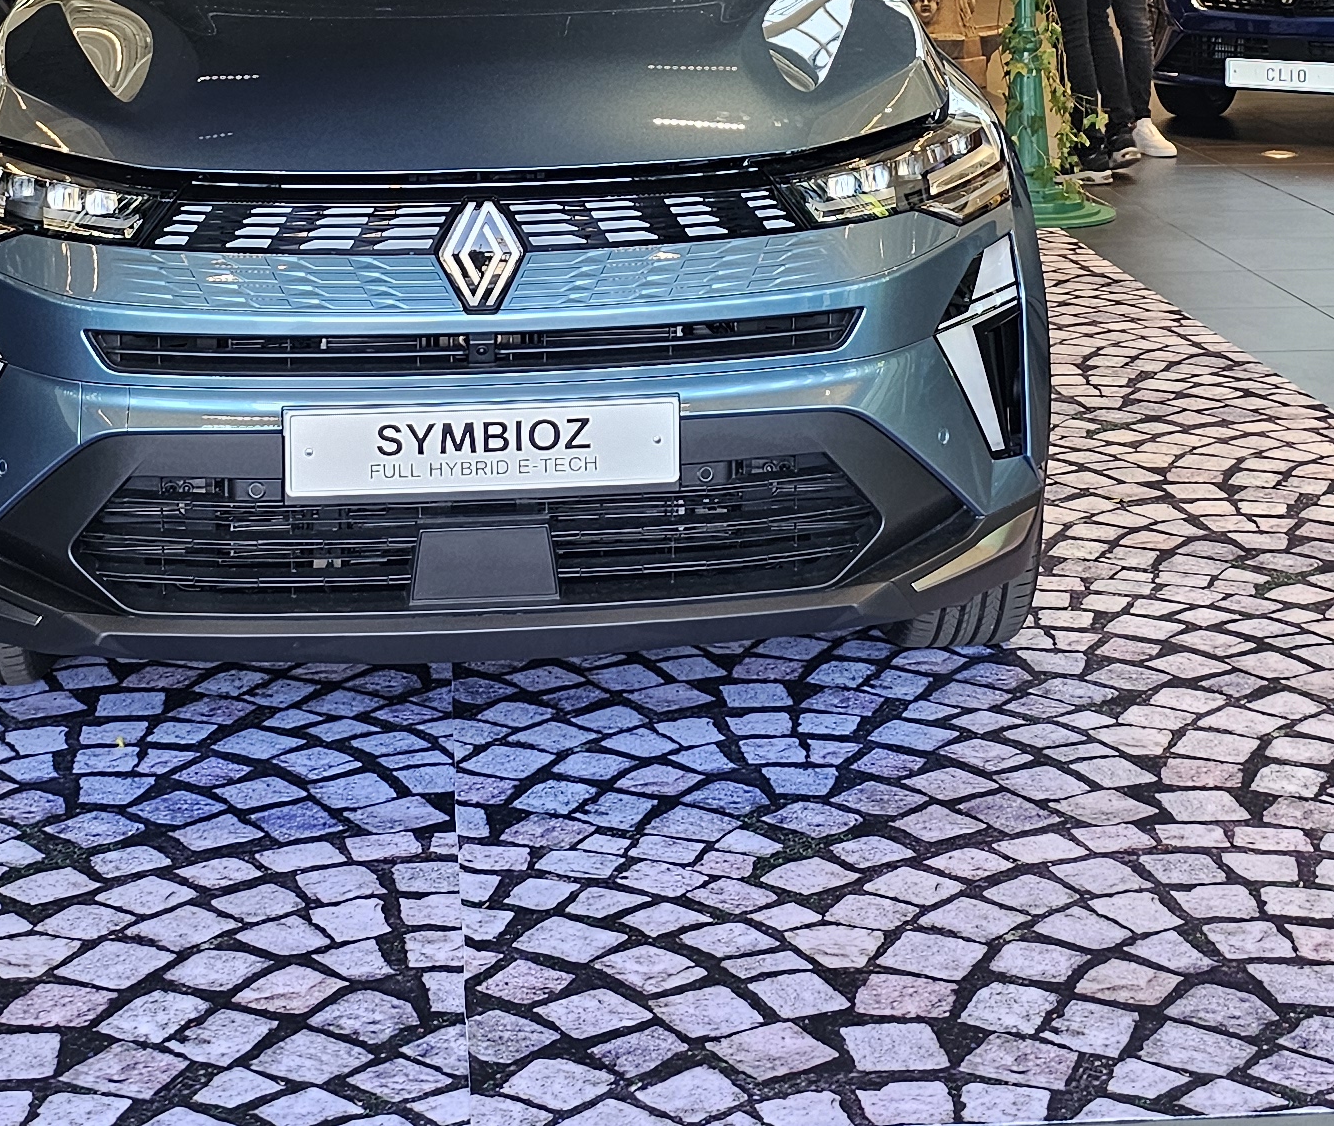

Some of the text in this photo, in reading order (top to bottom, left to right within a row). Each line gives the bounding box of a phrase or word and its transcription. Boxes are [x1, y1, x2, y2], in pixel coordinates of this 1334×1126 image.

[1266, 67, 1307, 83] CLIO
[376, 417, 592, 457] SYMBIOZ
[370, 456, 598, 480] FULL HYBRID E-TECH
